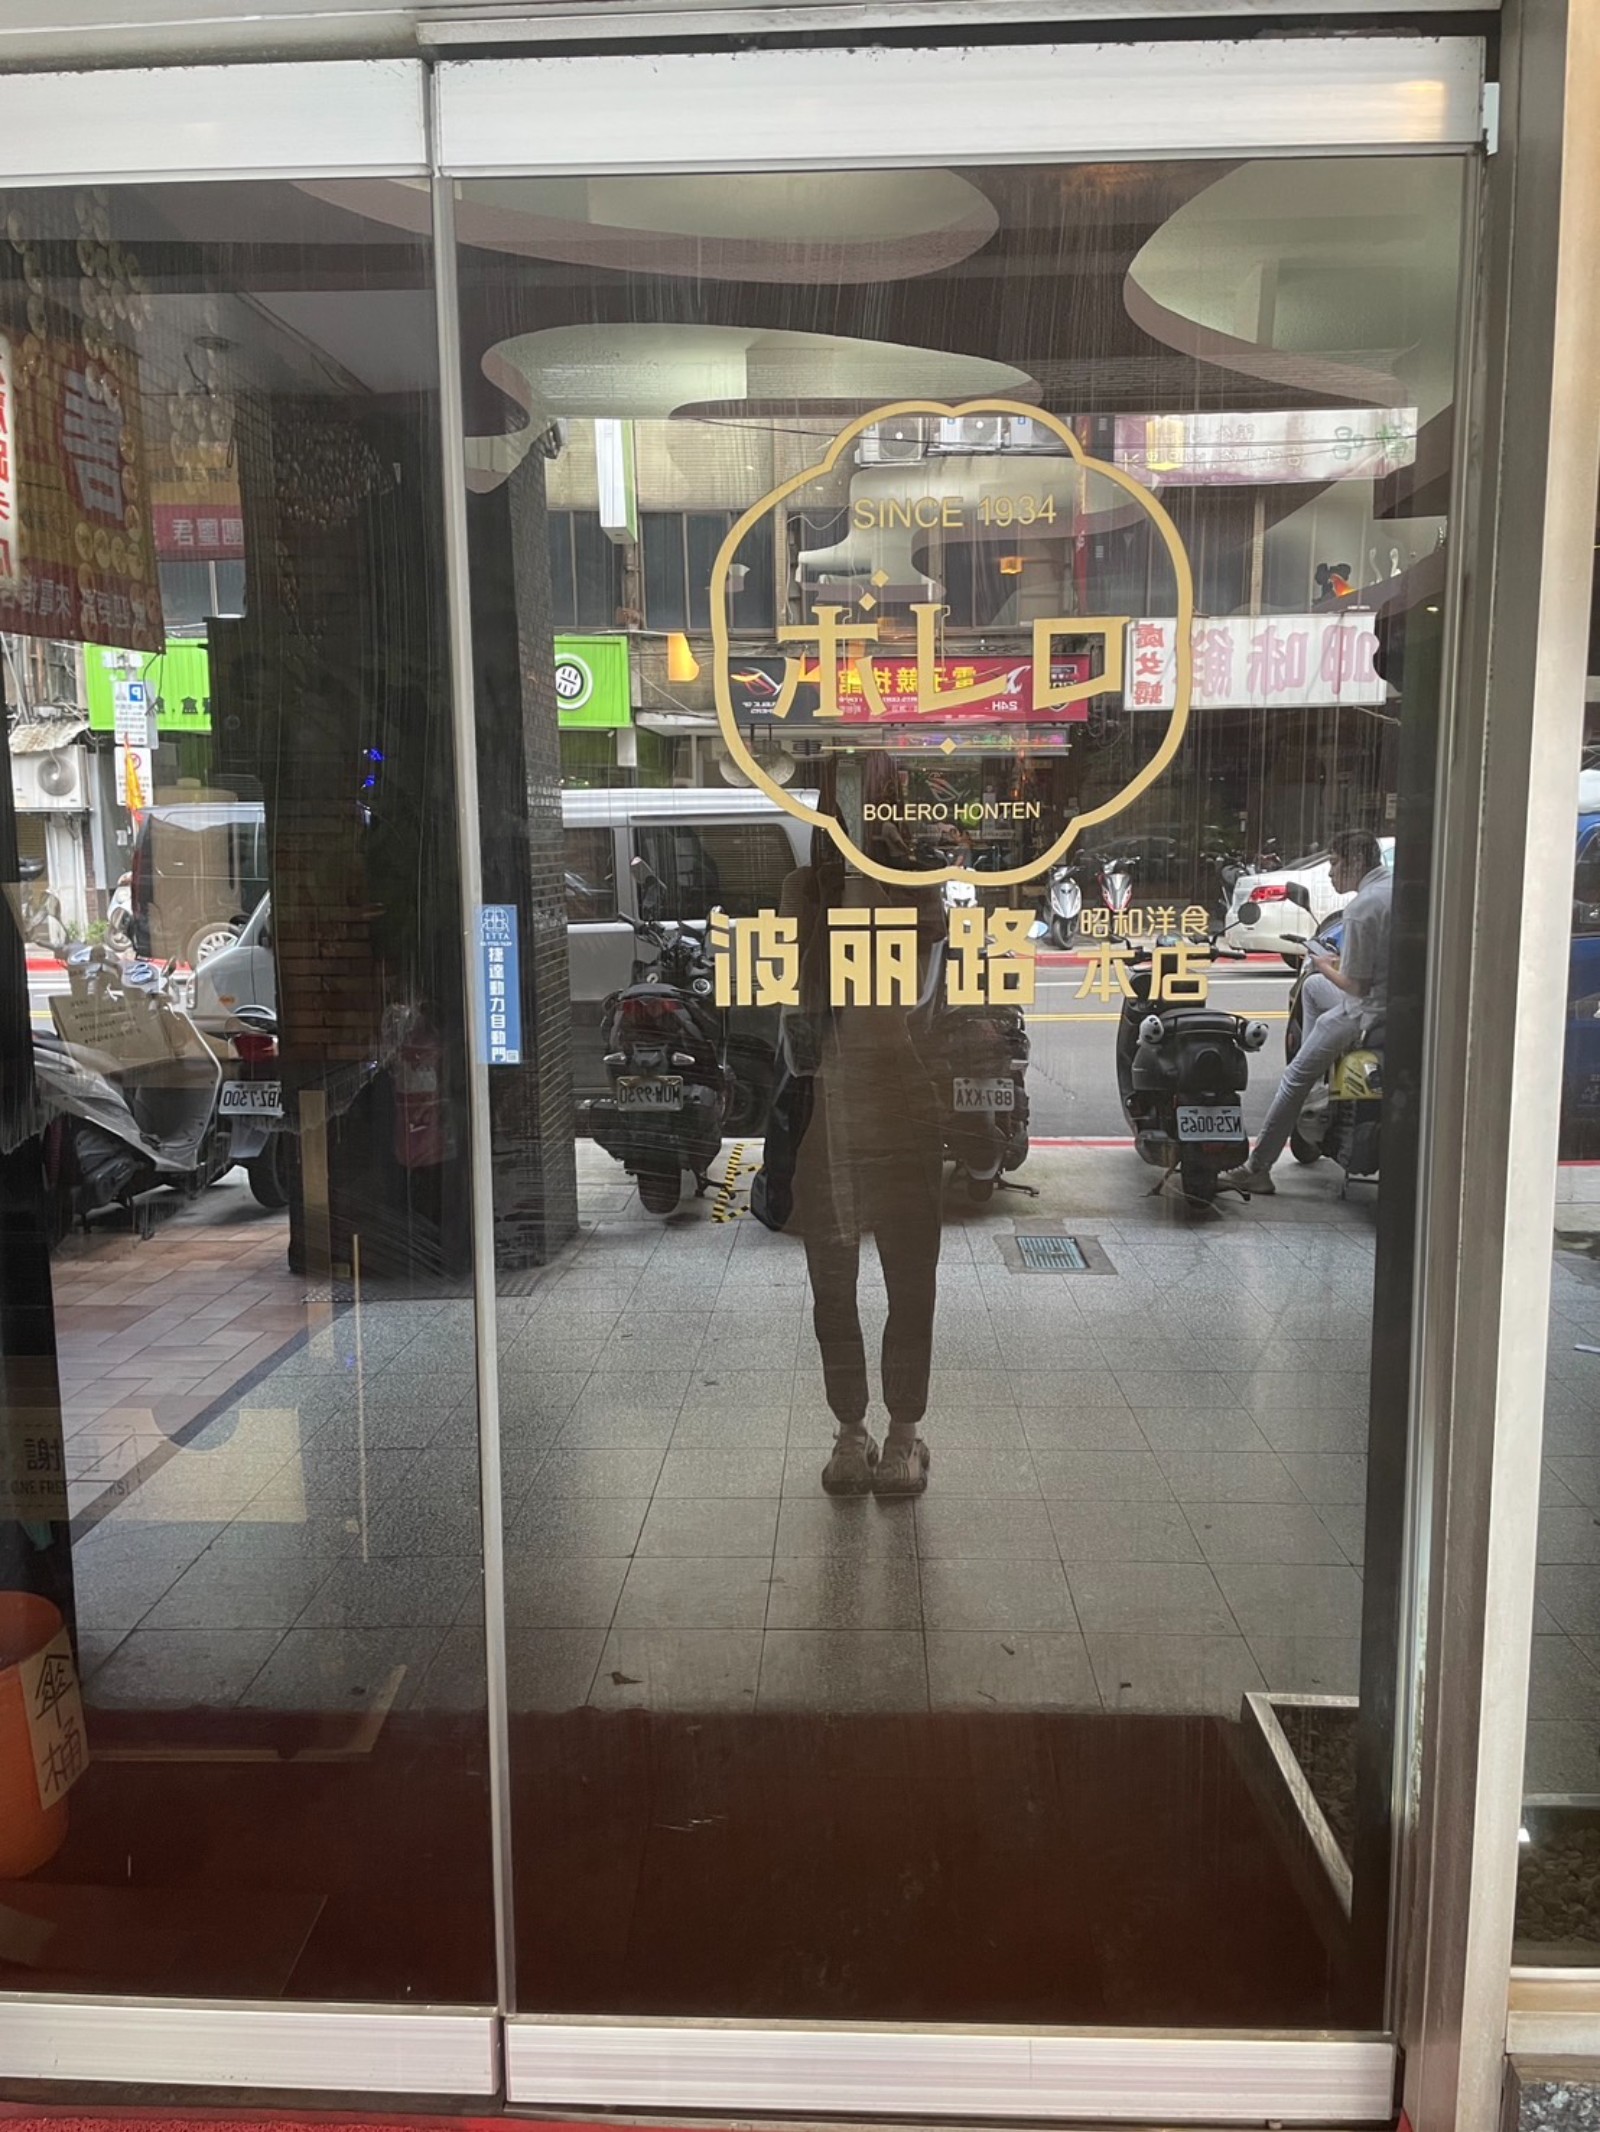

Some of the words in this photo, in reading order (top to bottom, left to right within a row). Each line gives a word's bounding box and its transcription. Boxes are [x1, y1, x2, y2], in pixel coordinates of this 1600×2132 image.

[854, 496, 964, 530] SINCE
[980, 494, 1056, 526] 1934
[772, 569, 1130, 719] ボレロ
[863, 804, 949, 821] BOLERO
[954, 803, 1040, 820] HONTEN
[710, 906, 1037, 1007] 波丽路
[1080, 905, 1210, 937] 昭和洋食
[488, 947, 507, 1063] 捷達動力自動門
[1074, 942, 1211, 1002] 本店
[34, 1652, 83, 1794] 傘桶
